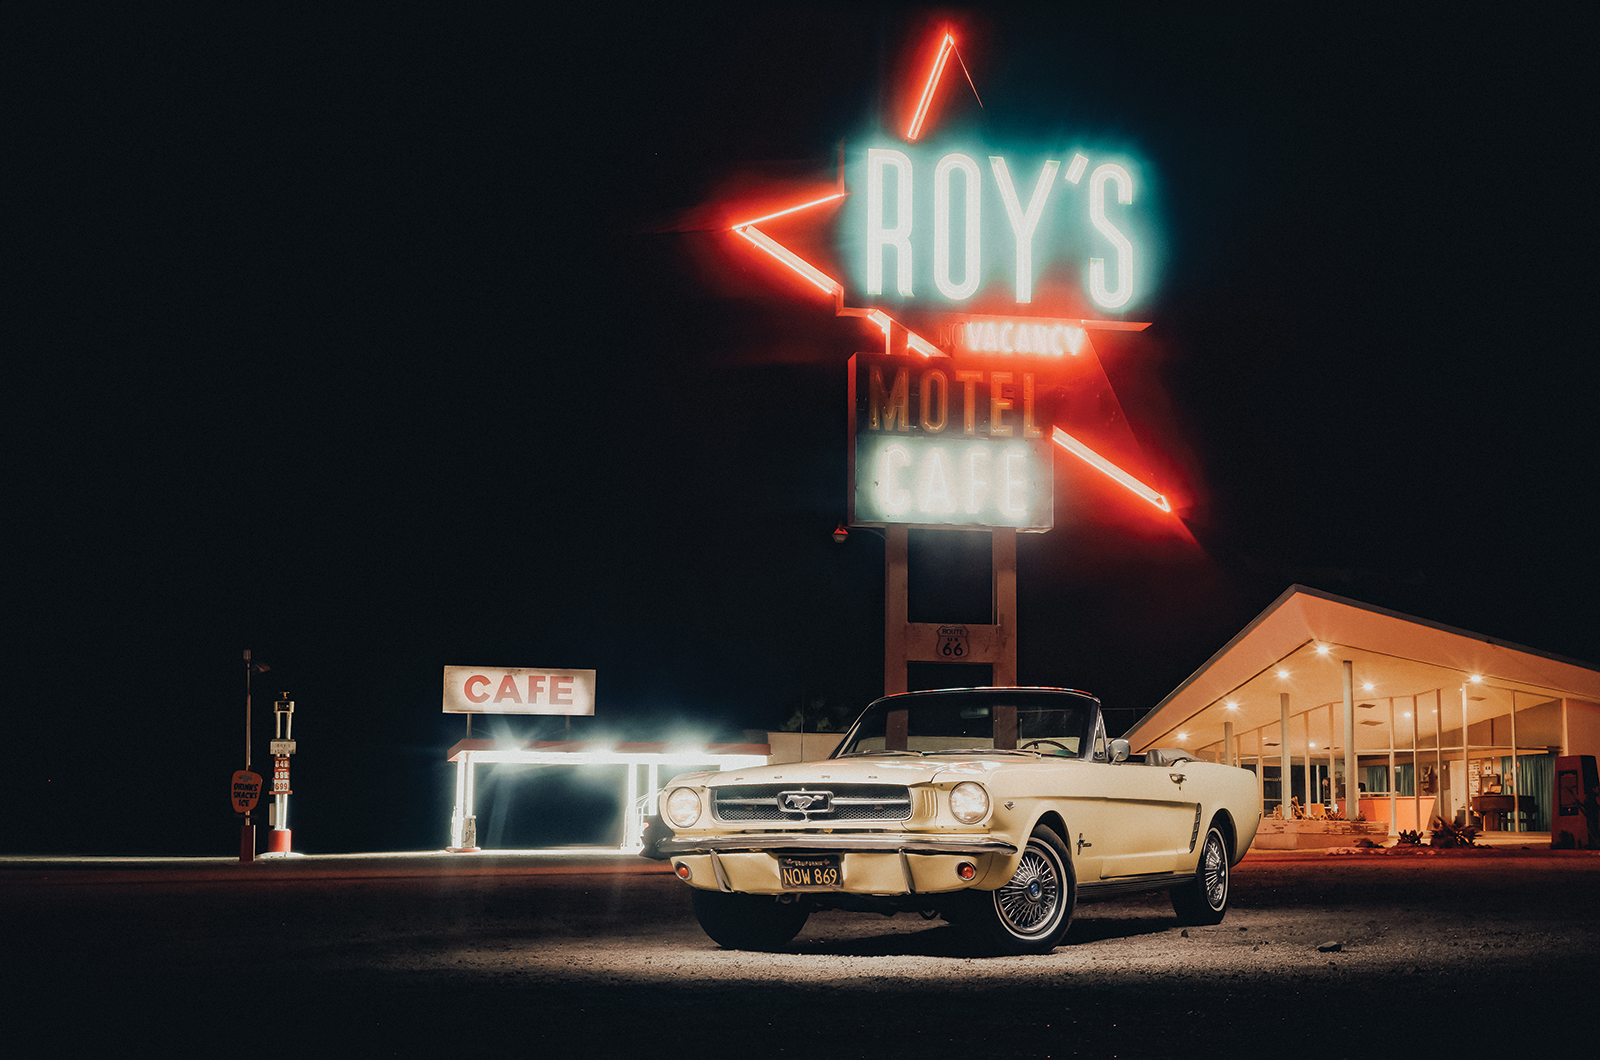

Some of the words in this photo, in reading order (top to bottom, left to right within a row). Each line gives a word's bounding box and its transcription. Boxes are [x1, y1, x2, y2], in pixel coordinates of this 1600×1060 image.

[867, 148, 1134, 309] ROY'S
[967, 322, 1083, 356] VACANCY
[868, 364, 1043, 438] MOTEL
[876, 444, 1028, 519] CAFE
[943, 642, 963, 656] 66
[464, 674, 574, 705] CAFE
[233, 782, 259, 792] DRINKS
[233, 791, 258, 799] SNACKS
[238, 799, 250, 807] ICE
[783, 868, 811, 885] NOW
[814, 868, 837, 885] 869
